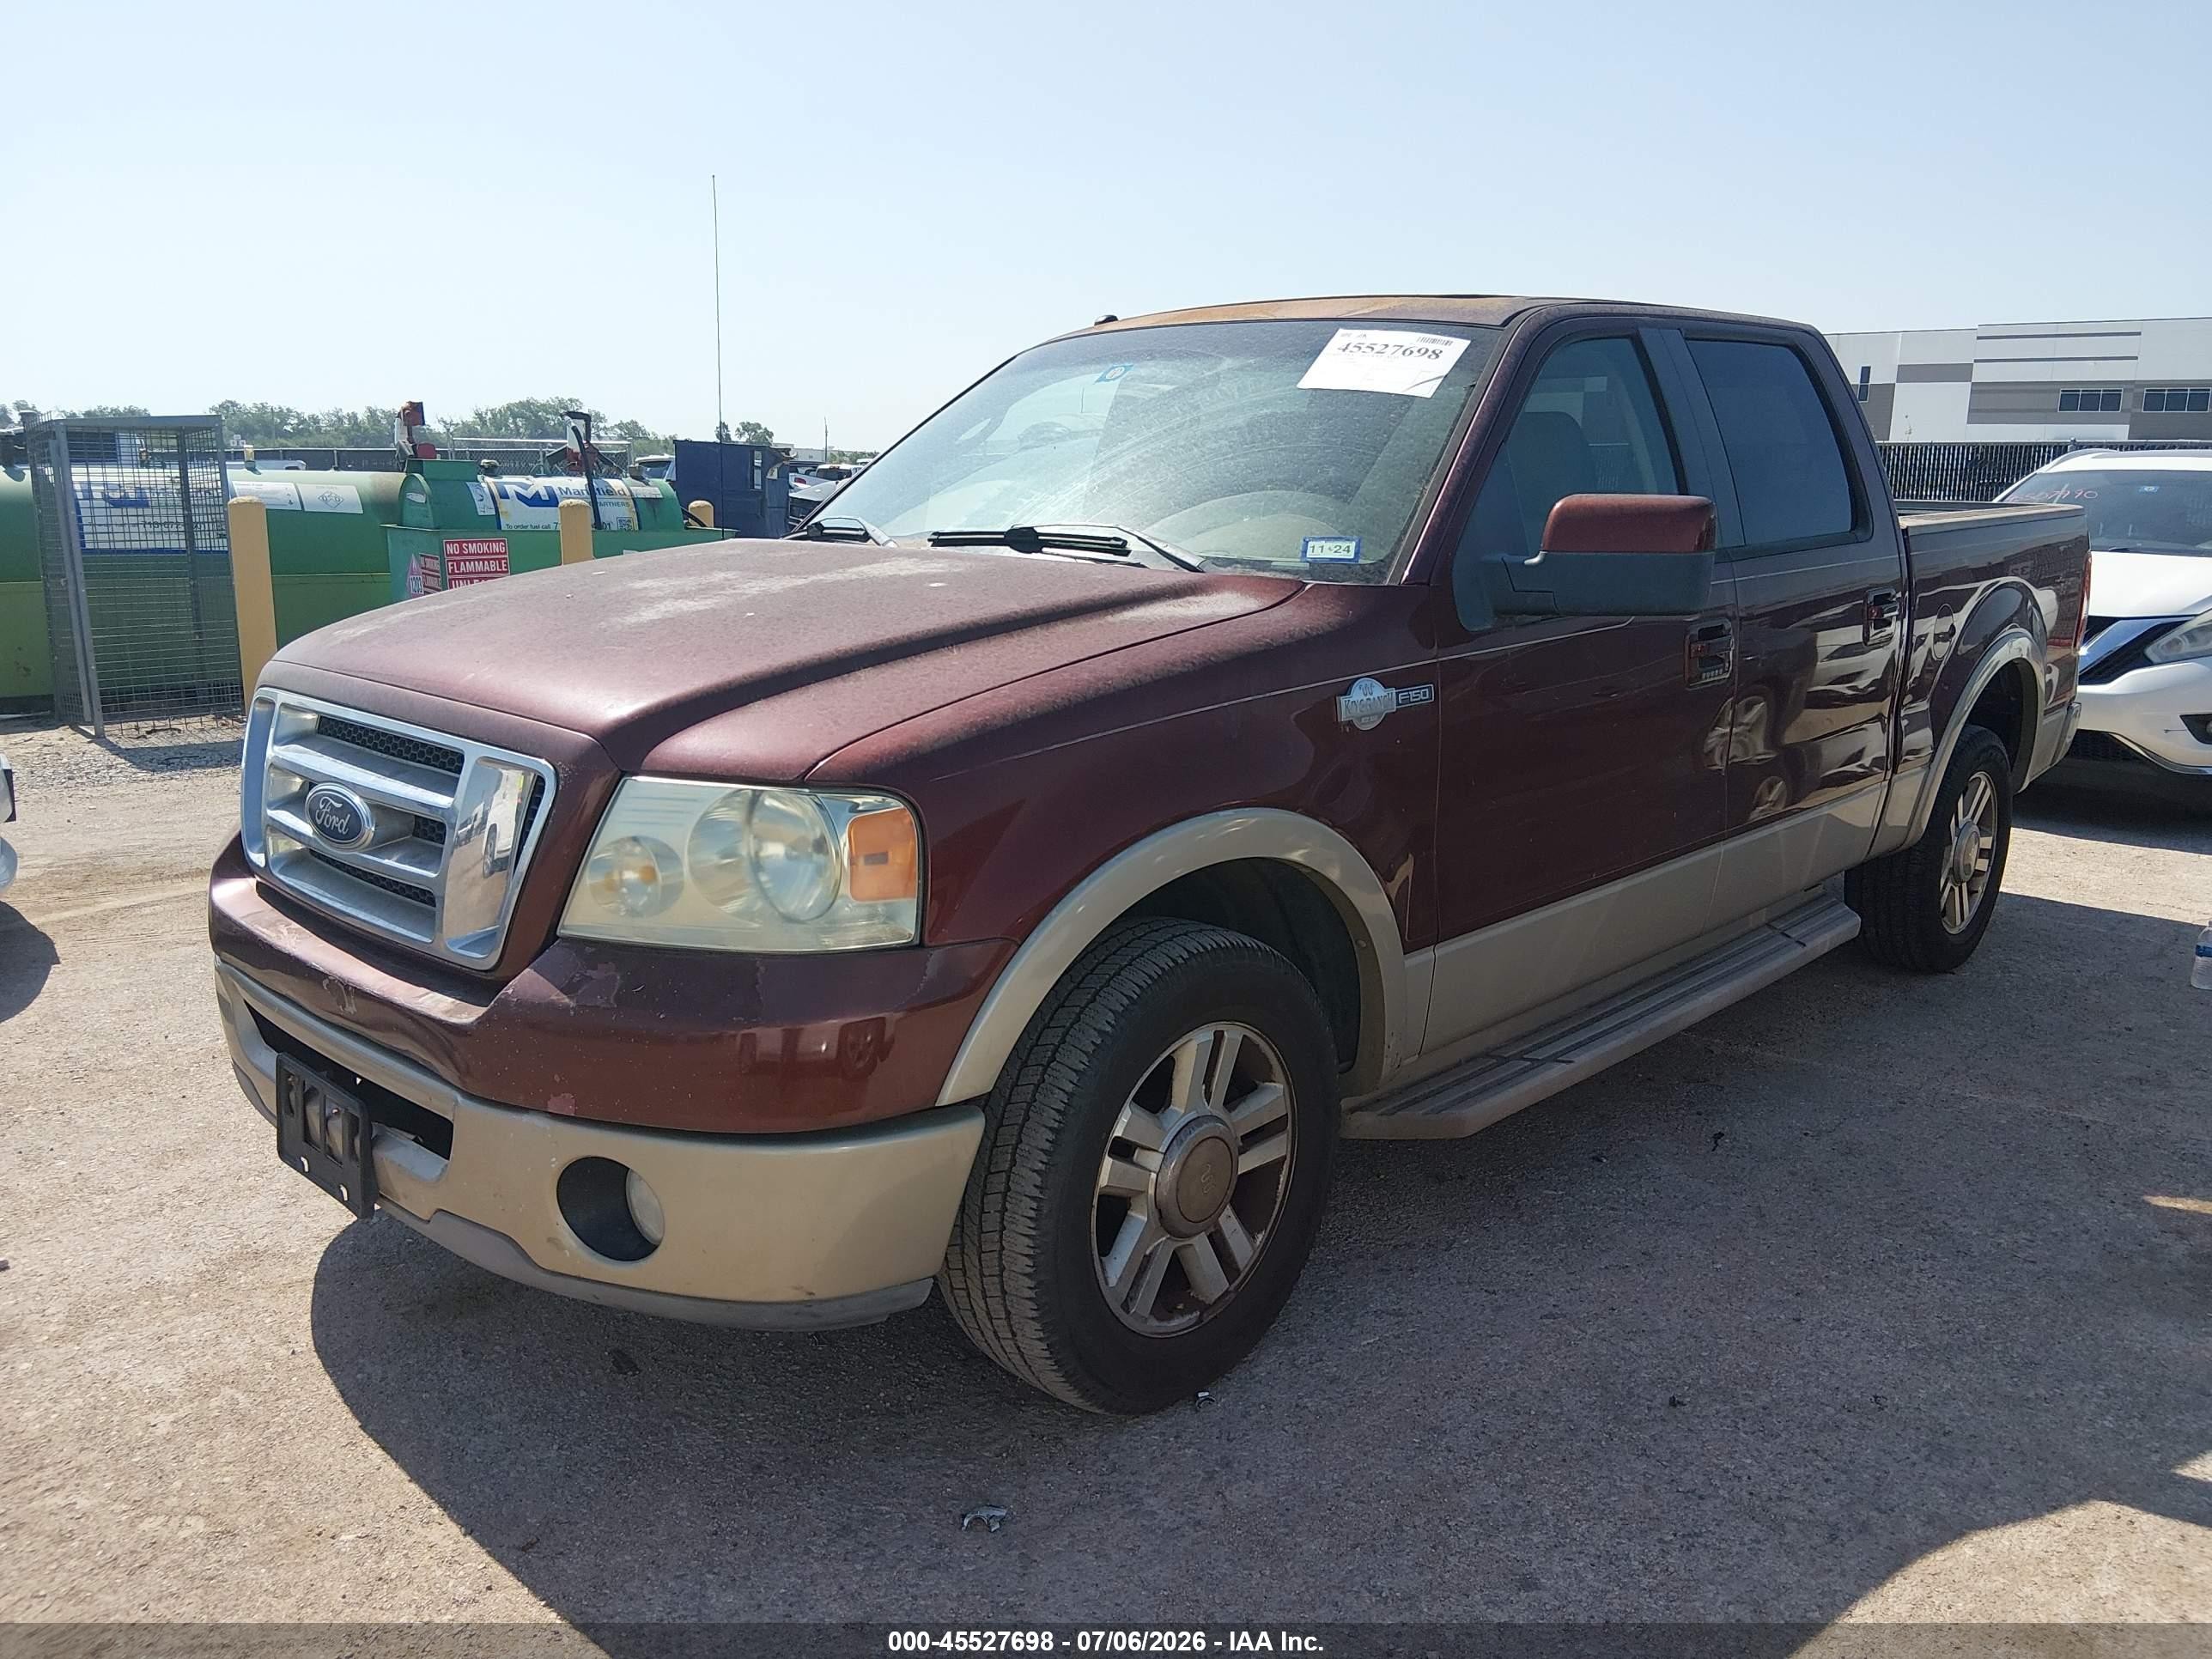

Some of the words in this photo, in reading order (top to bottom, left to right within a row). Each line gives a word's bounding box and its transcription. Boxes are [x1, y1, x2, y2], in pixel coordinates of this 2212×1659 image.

[1338, 342, 1443, 361] 45527698
[559, 486, 628, 496] Manfield
[447, 544, 460, 555] NO
[462, 542, 506, 555] SMOKING
[448, 560, 507, 573] FLAMMABLE
[410, 577, 423, 593] 1203
[315, 796, 350, 835] Ford
